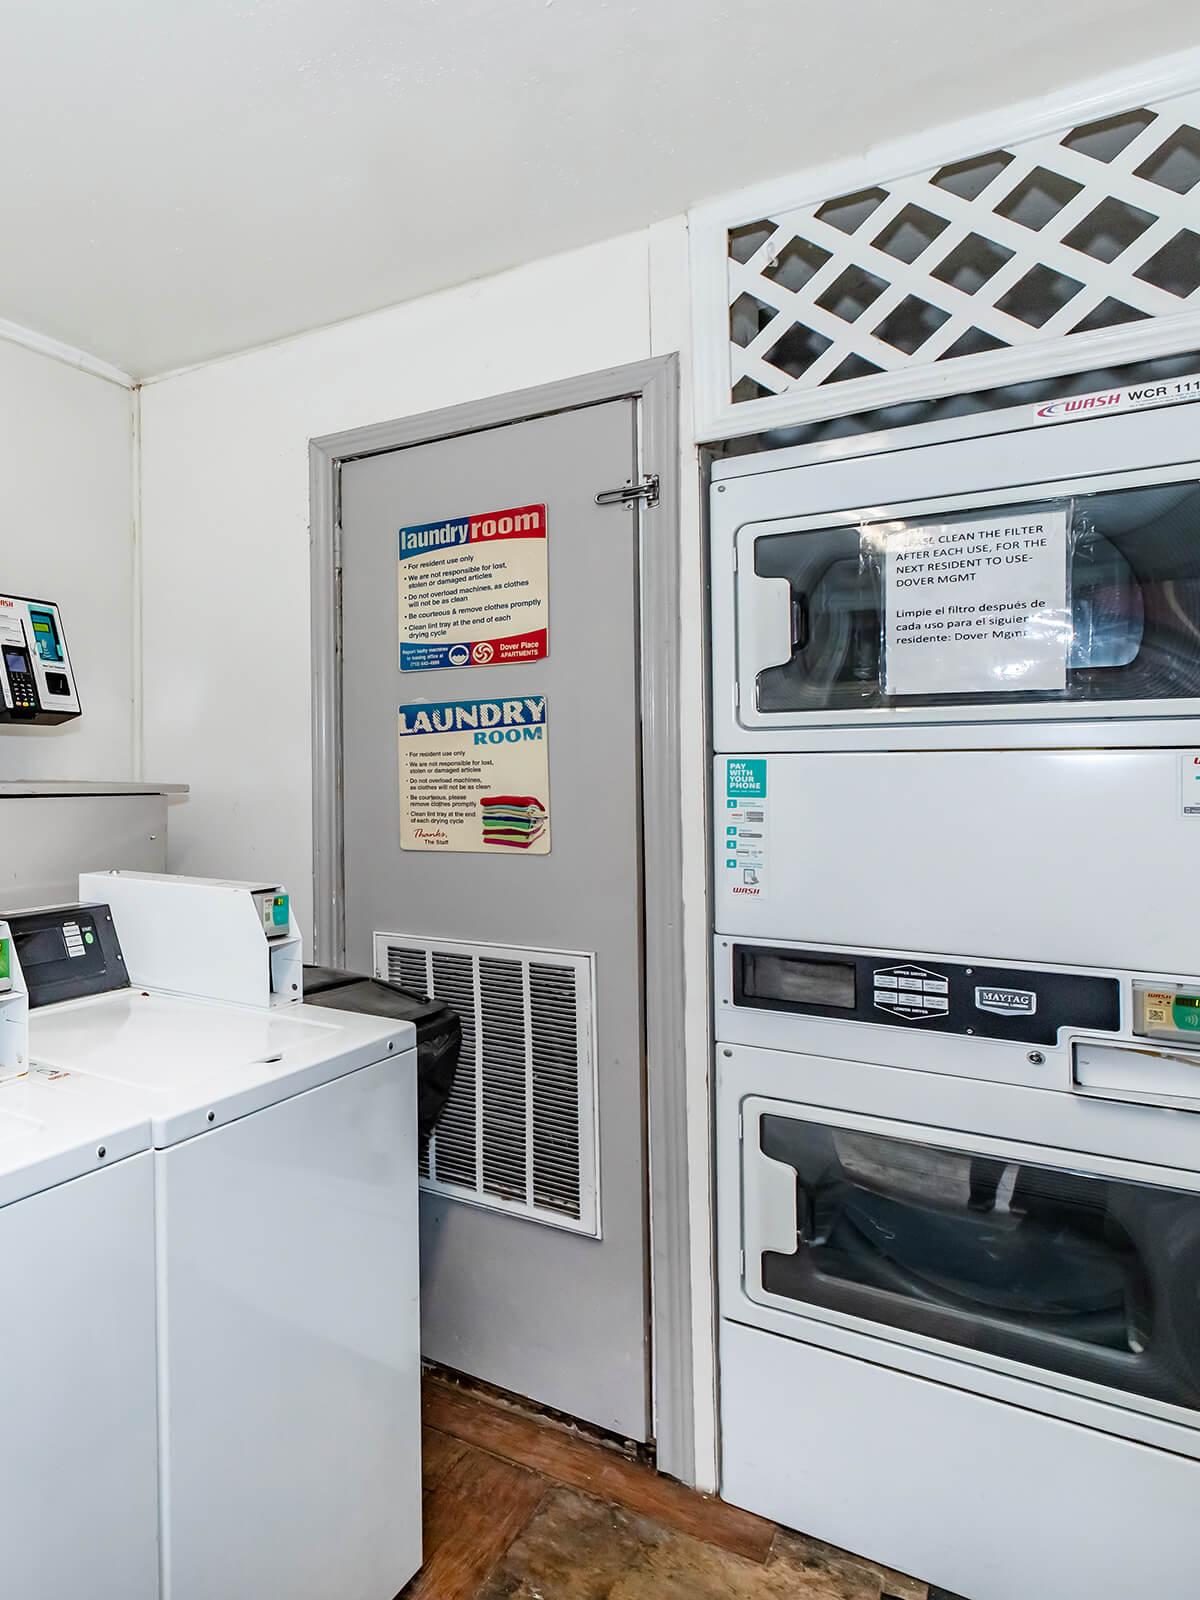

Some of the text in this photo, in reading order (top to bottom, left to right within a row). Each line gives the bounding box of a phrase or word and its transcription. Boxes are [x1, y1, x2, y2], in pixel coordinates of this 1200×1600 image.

[1064, 393, 1121, 412] WASH
[1128, 386, 1167, 401] WCR
[400, 512, 540, 550] laundry room
[938, 532, 975, 544] CLEAN
[978, 529, 1001, 539] THE
[1004, 525, 1043, 537] FILTER
[896, 538, 1047, 562] AFTER EACH USE, FOR THE
[420, 559, 445, 568] resident
[460, 554, 474, 563] only
[896, 554, 1033, 574] NEXT RESIDENT TO USE-
[442, 566, 480, 577] responsible
[408, 581, 428, 589] stolen
[436, 575, 467, 586] damaged
[468, 572, 492, 581] articles
[896, 572, 977, 588] DOVER MGMT
[430, 588, 458, 599] overload
[503, 579, 529, 588] clothes
[450, 595, 468, 603] clean
[418, 609, 450, 619] courteous
[458, 606, 483, 614] remove
[484, 602, 508, 611] clothes
[510, 598, 541, 609] promptly
[896, 599, 1046, 619] Limpie el filtro después de
[439, 621, 451, 630] tray
[494, 614, 511, 622] each
[896, 617, 986, 631] cada uso para el
[408, 629, 447, 640] drying cycle
[896, 632, 988, 645] residente: Dover
[500, 642, 519, 651] Dover
[500, 649, 538, 658] APARTMENTS
[400, 699, 545, 734] LAUNDRY
[473, 726, 542, 745] ROOM
[729, 782, 761, 790] PHONE
[414, 828, 448, 838] Thanks,
[732, 886, 760, 895] WASH
[983, 991, 1029, 1004] MAYTAG
